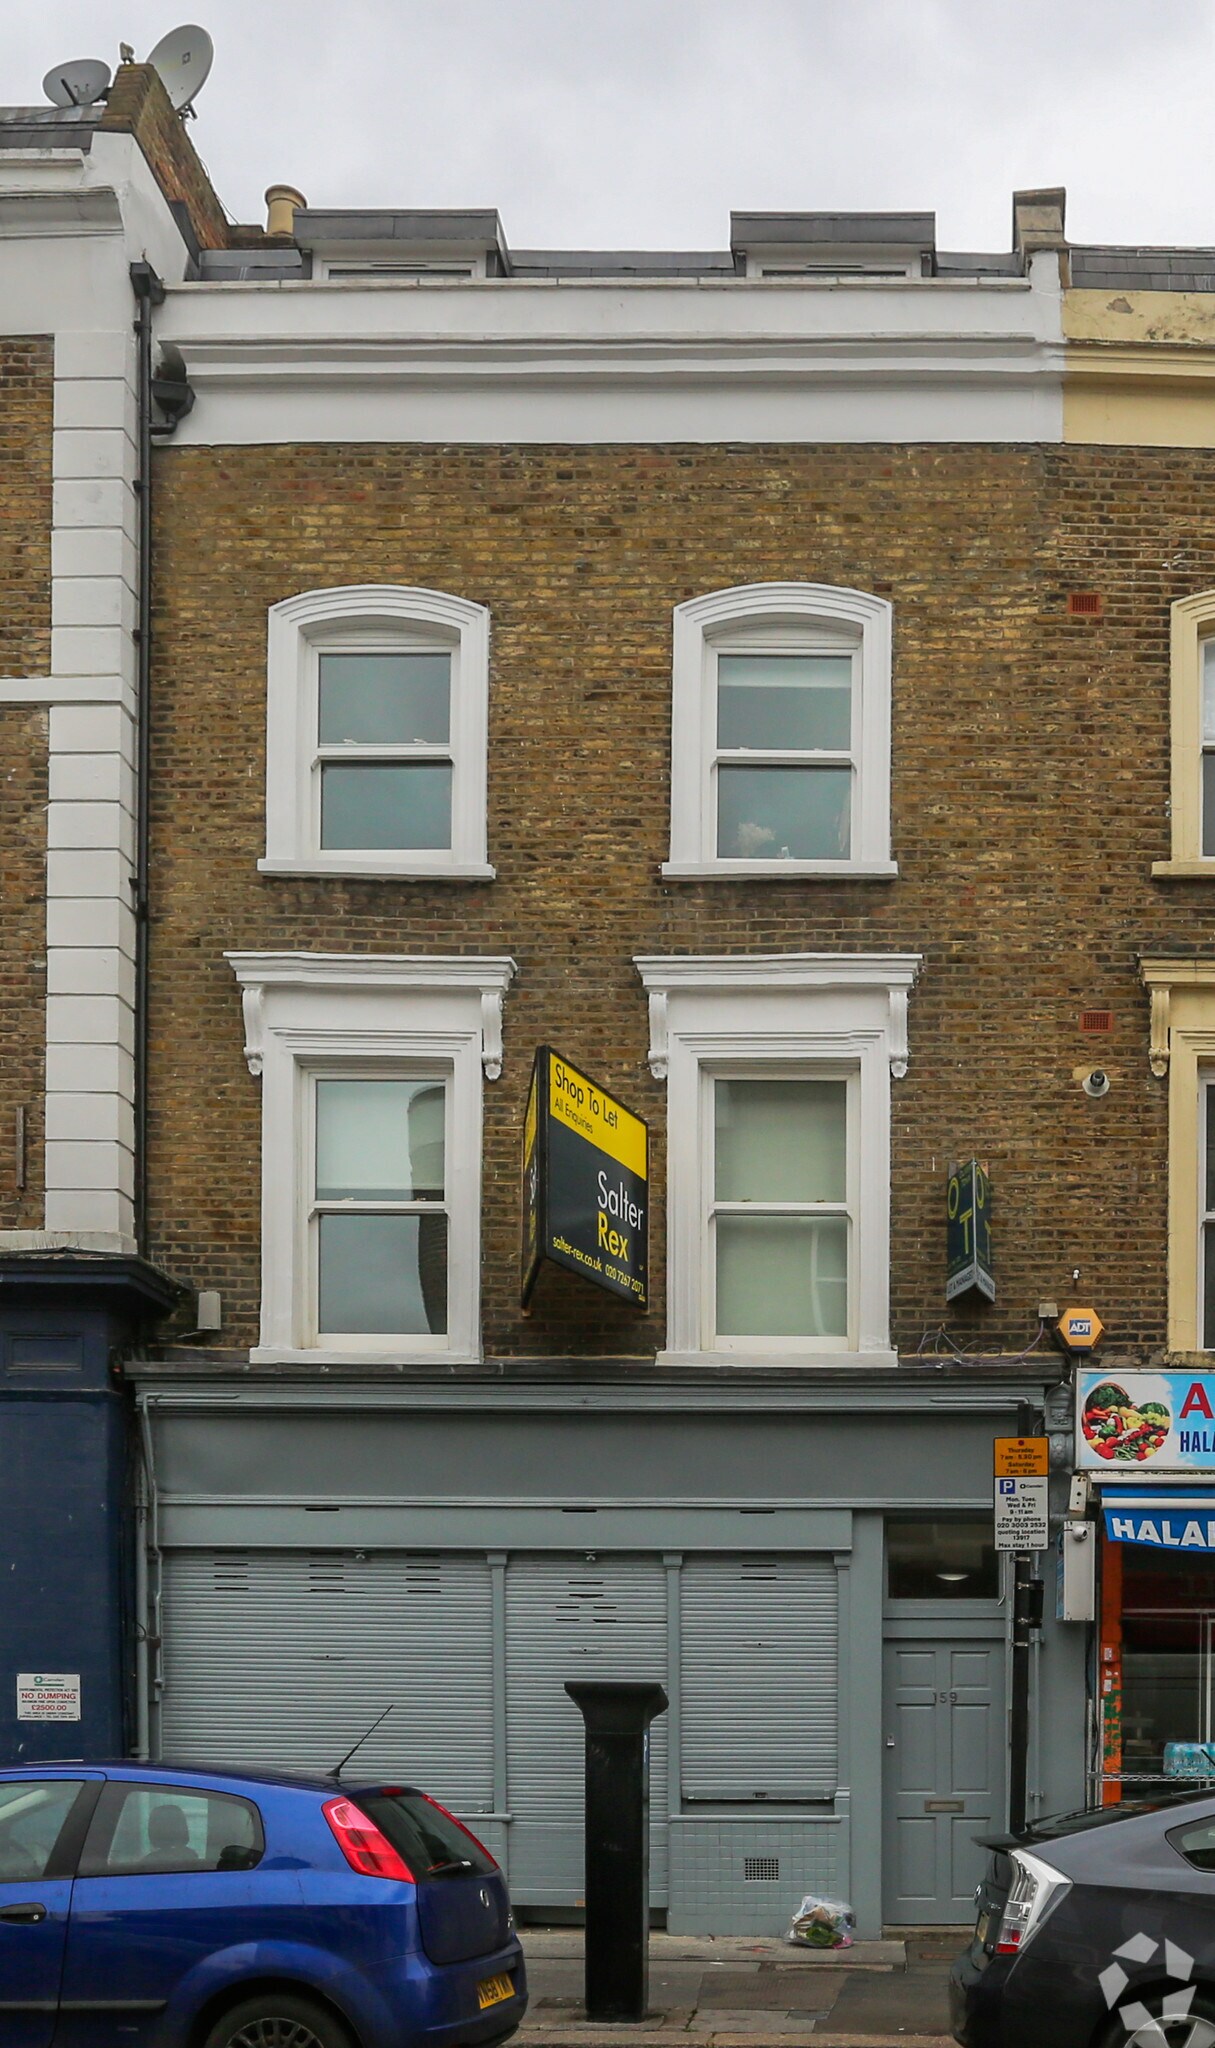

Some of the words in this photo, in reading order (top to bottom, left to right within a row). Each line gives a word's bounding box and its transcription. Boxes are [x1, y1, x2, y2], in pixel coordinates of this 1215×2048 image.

[554, 1097, 564, 1112] All
[565, 1103, 593, 1134] Enquiries
[555, 1063, 584, 1108] Shop
[587, 1087, 600, 1115] To
[603, 1099, 618, 1130] Let
[597, 1170, 643, 1231] Salter
[598, 1211, 629, 1262] Rex
[552, 1236, 602, 1272] salter-rex.co.uk
[605, 1264, 617, 1279] 020
[1069, 1322, 1091, 1332] ADT
[1003, 1481, 1013, 1493] P
[932, 1691, 957, 1704] 159
